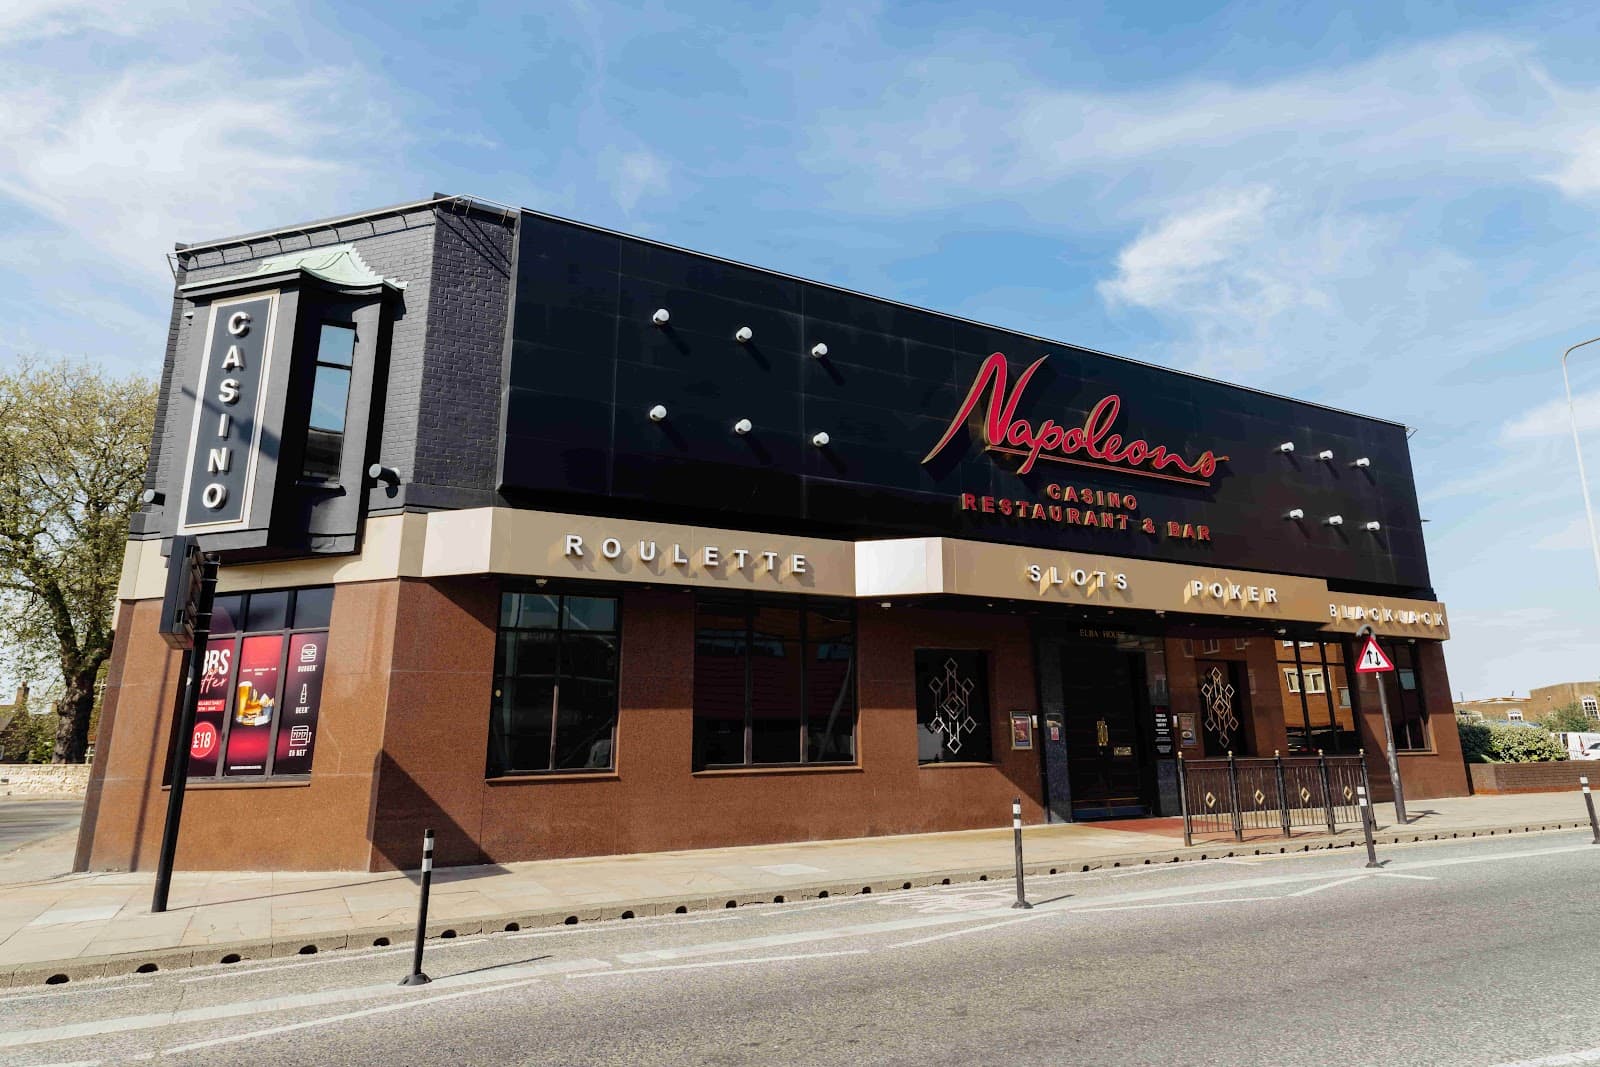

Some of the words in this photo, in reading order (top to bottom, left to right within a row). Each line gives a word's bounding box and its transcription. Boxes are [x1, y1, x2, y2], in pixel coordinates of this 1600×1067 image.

[202, 311, 250, 510] CASINO
[921, 352, 1230, 476] Napoleons
[1046, 483, 1137, 511] CASINO
[961, 493, 1129, 530] RESTAURANT
[1142, 517, 1156, 534] &
[1167, 520, 1211, 541] BAR
[565, 534, 806, 573] ROULETTE
[1028, 564, 1128, 590] SLOTS
[1191, 579, 1278, 603] POKER
[1329, 604, 1445, 626] BLACKJACK
[192, 732, 211, 748] £18
